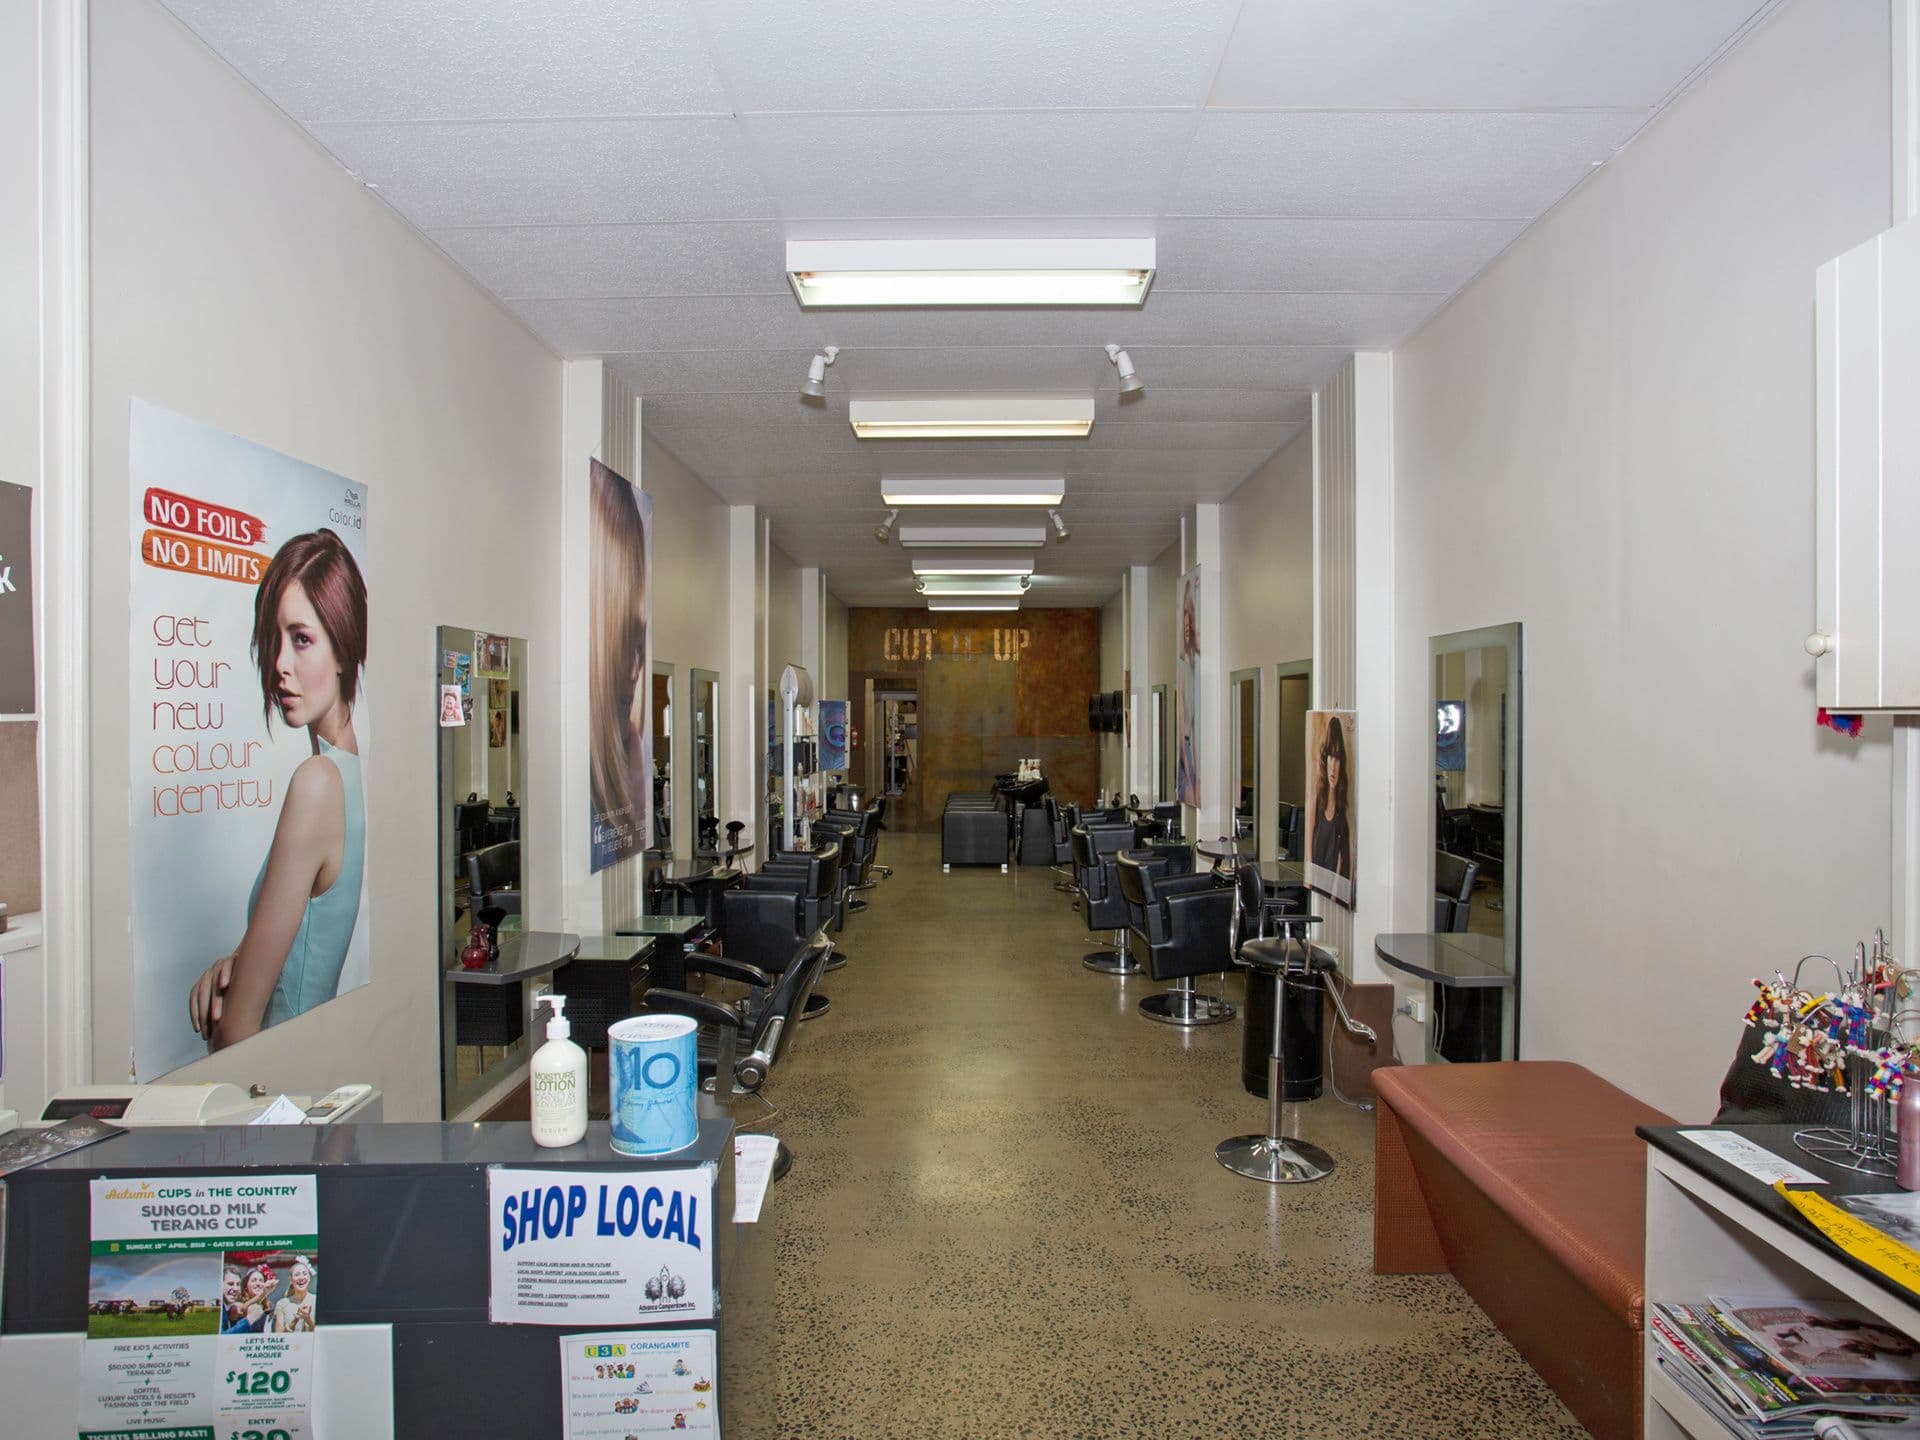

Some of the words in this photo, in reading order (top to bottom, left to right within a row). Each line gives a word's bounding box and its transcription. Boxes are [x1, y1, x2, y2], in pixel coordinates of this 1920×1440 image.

[151, 495, 190, 528] NO
[197, 507, 251, 544] FOILS
[152, 536, 190, 567] NO
[197, 546, 260, 580] LIMITS
[153, 615, 212, 648] get
[884, 628, 937, 661] CUT
[993, 628, 1030, 661] UP
[154, 658, 231, 690] your
[153, 702, 224, 730] new
[153, 779, 273, 817] identity
[535, 1071, 576, 1082] MOISTURE
[627, 1047, 681, 1091] 10
[535, 1080, 576, 1092] LOTION
[105, 1187, 155, 1200] Autumn
[158, 1189, 192, 1199] CUPS
[195, 1188, 205, 1198] in
[208, 1187, 233, 1198] THE
[237, 1186, 298, 1196] COUNTRY
[141, 1204, 221, 1217] SUNGOLD
[227, 1203, 267, 1215] MILK
[150, 1218, 219, 1231] TERANG
[224, 1217, 259, 1230] CUP
[503, 1185, 586, 1251] SHOP
[597, 1185, 701, 1252] LOCAL
[630, 1342, 690, 1350] CORANGAMITE
[138, 1361, 173, 1369] SUNGOLD
